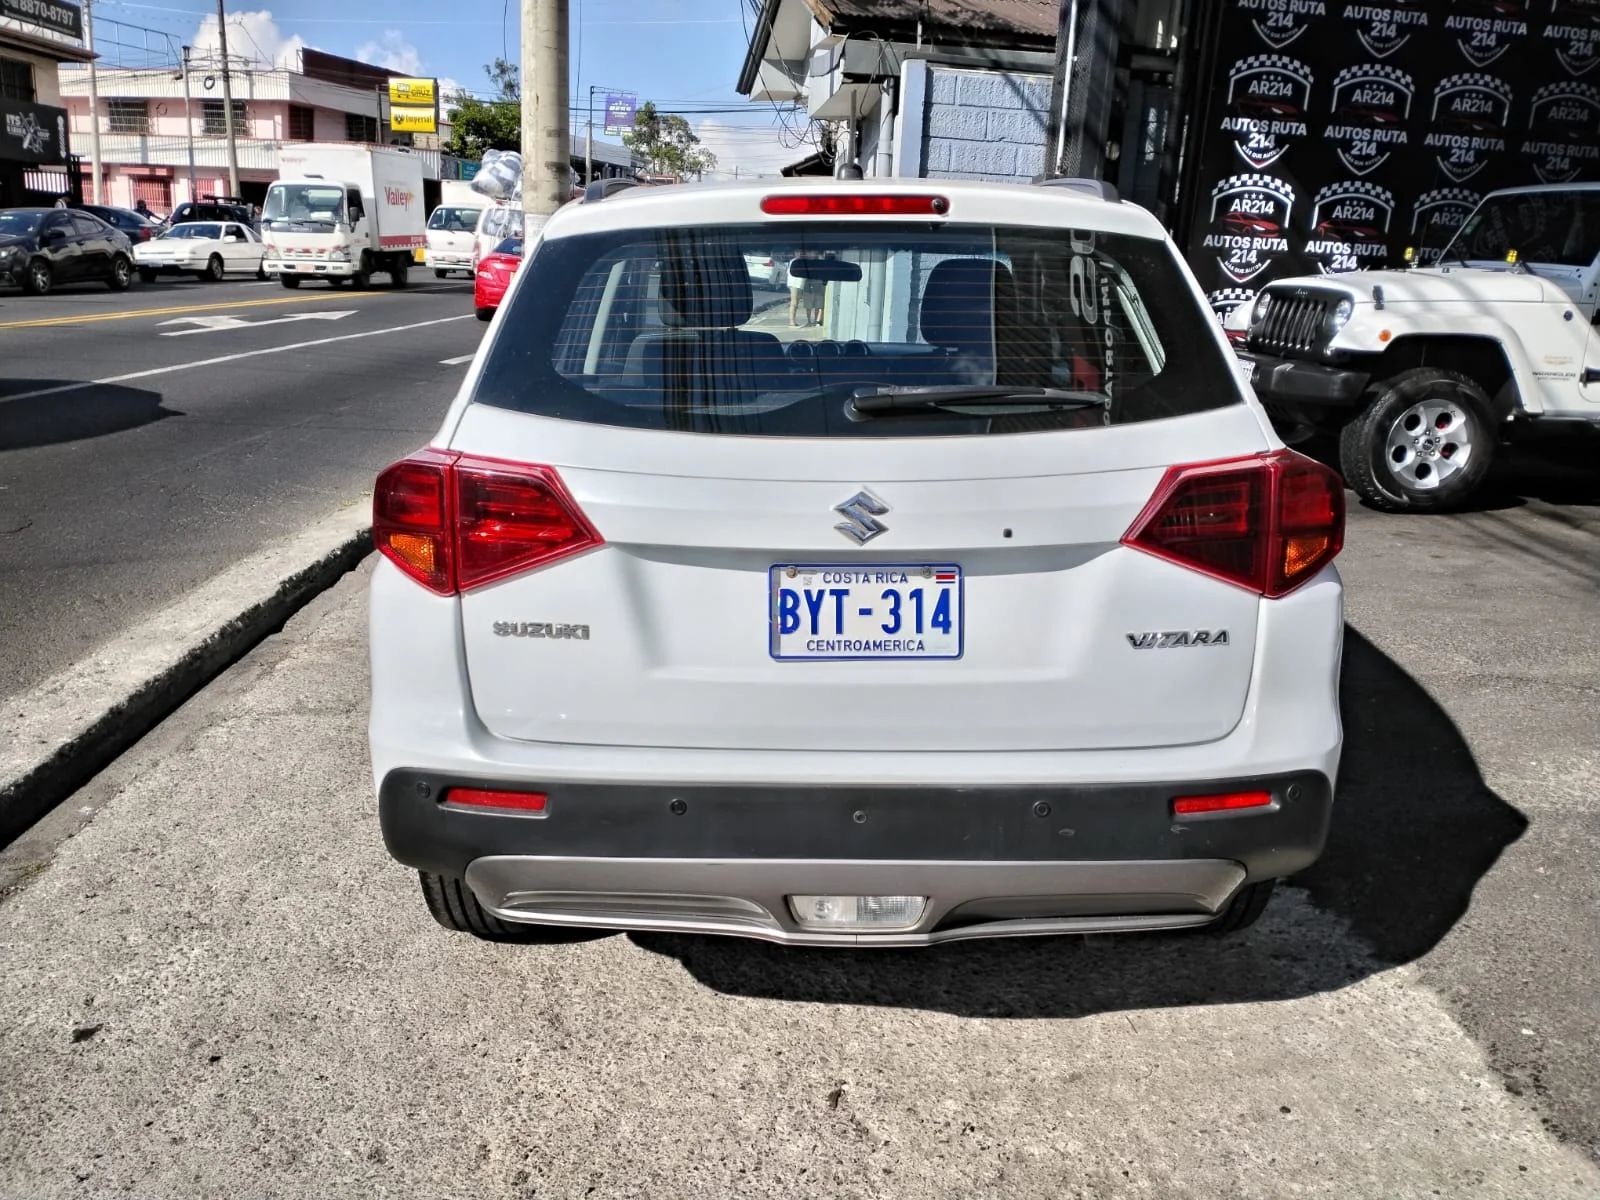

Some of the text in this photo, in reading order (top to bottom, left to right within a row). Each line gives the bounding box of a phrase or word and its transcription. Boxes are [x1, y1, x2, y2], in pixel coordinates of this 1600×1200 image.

[19, 0, 74, 26] 8870-8797
[1238, 0, 1326, 15] AUTOS RUTA
[1343, 5, 1428, 26] AUTOS RUTA
[1266, 11, 1295, 28] 214
[1444, 15, 1527, 35] AUTOS RUTA
[1370, 21, 1397, 38] 214
[1543, 25, 1588, 40] AUTOS
[1471, 31, 1497, 48] 214
[1568, 41, 1594, 57] 214
[1248, 80, 1293, 97] AR214
[1351, 88, 1394, 105] AR214
[1451, 97, 1494, 113] AR214
[1548, 105, 1589, 121] AR214
[1220, 116, 1307, 136] AUTOS RUTA
[1323, 124, 1408, 144] AUTOS RUTA
[1248, 132, 1276, 149] 214
[1350, 140, 1377, 156] 214
[1424, 132, 1505, 151] AUTOS RUTA
[1449, 149, 1476, 164] 214
[1521, 141, 1600, 159] AUTOS RUTA
[1545, 156, 1570, 171] 214
[384, 185, 409, 210] Valley
[1230, 198, 1275, 215] AR214
[1332, 205, 1375, 221] AR214
[1203, 234, 1289, 251] AUTOS RUTA
[1304, 240, 1388, 257] AUTOS RUTA
[1230, 248, 1258, 264] 214
[1331, 254, 1358, 270] 214
[822, 571, 871, 584] COSTA
[875, 572, 908, 584] RICA
[779, 587, 952, 635] BYT-314
[492, 620, 590, 640] SUZUKI
[806, 639, 925, 652] CENTROAMERICA
[1126, 630, 1230, 650] VITARA
